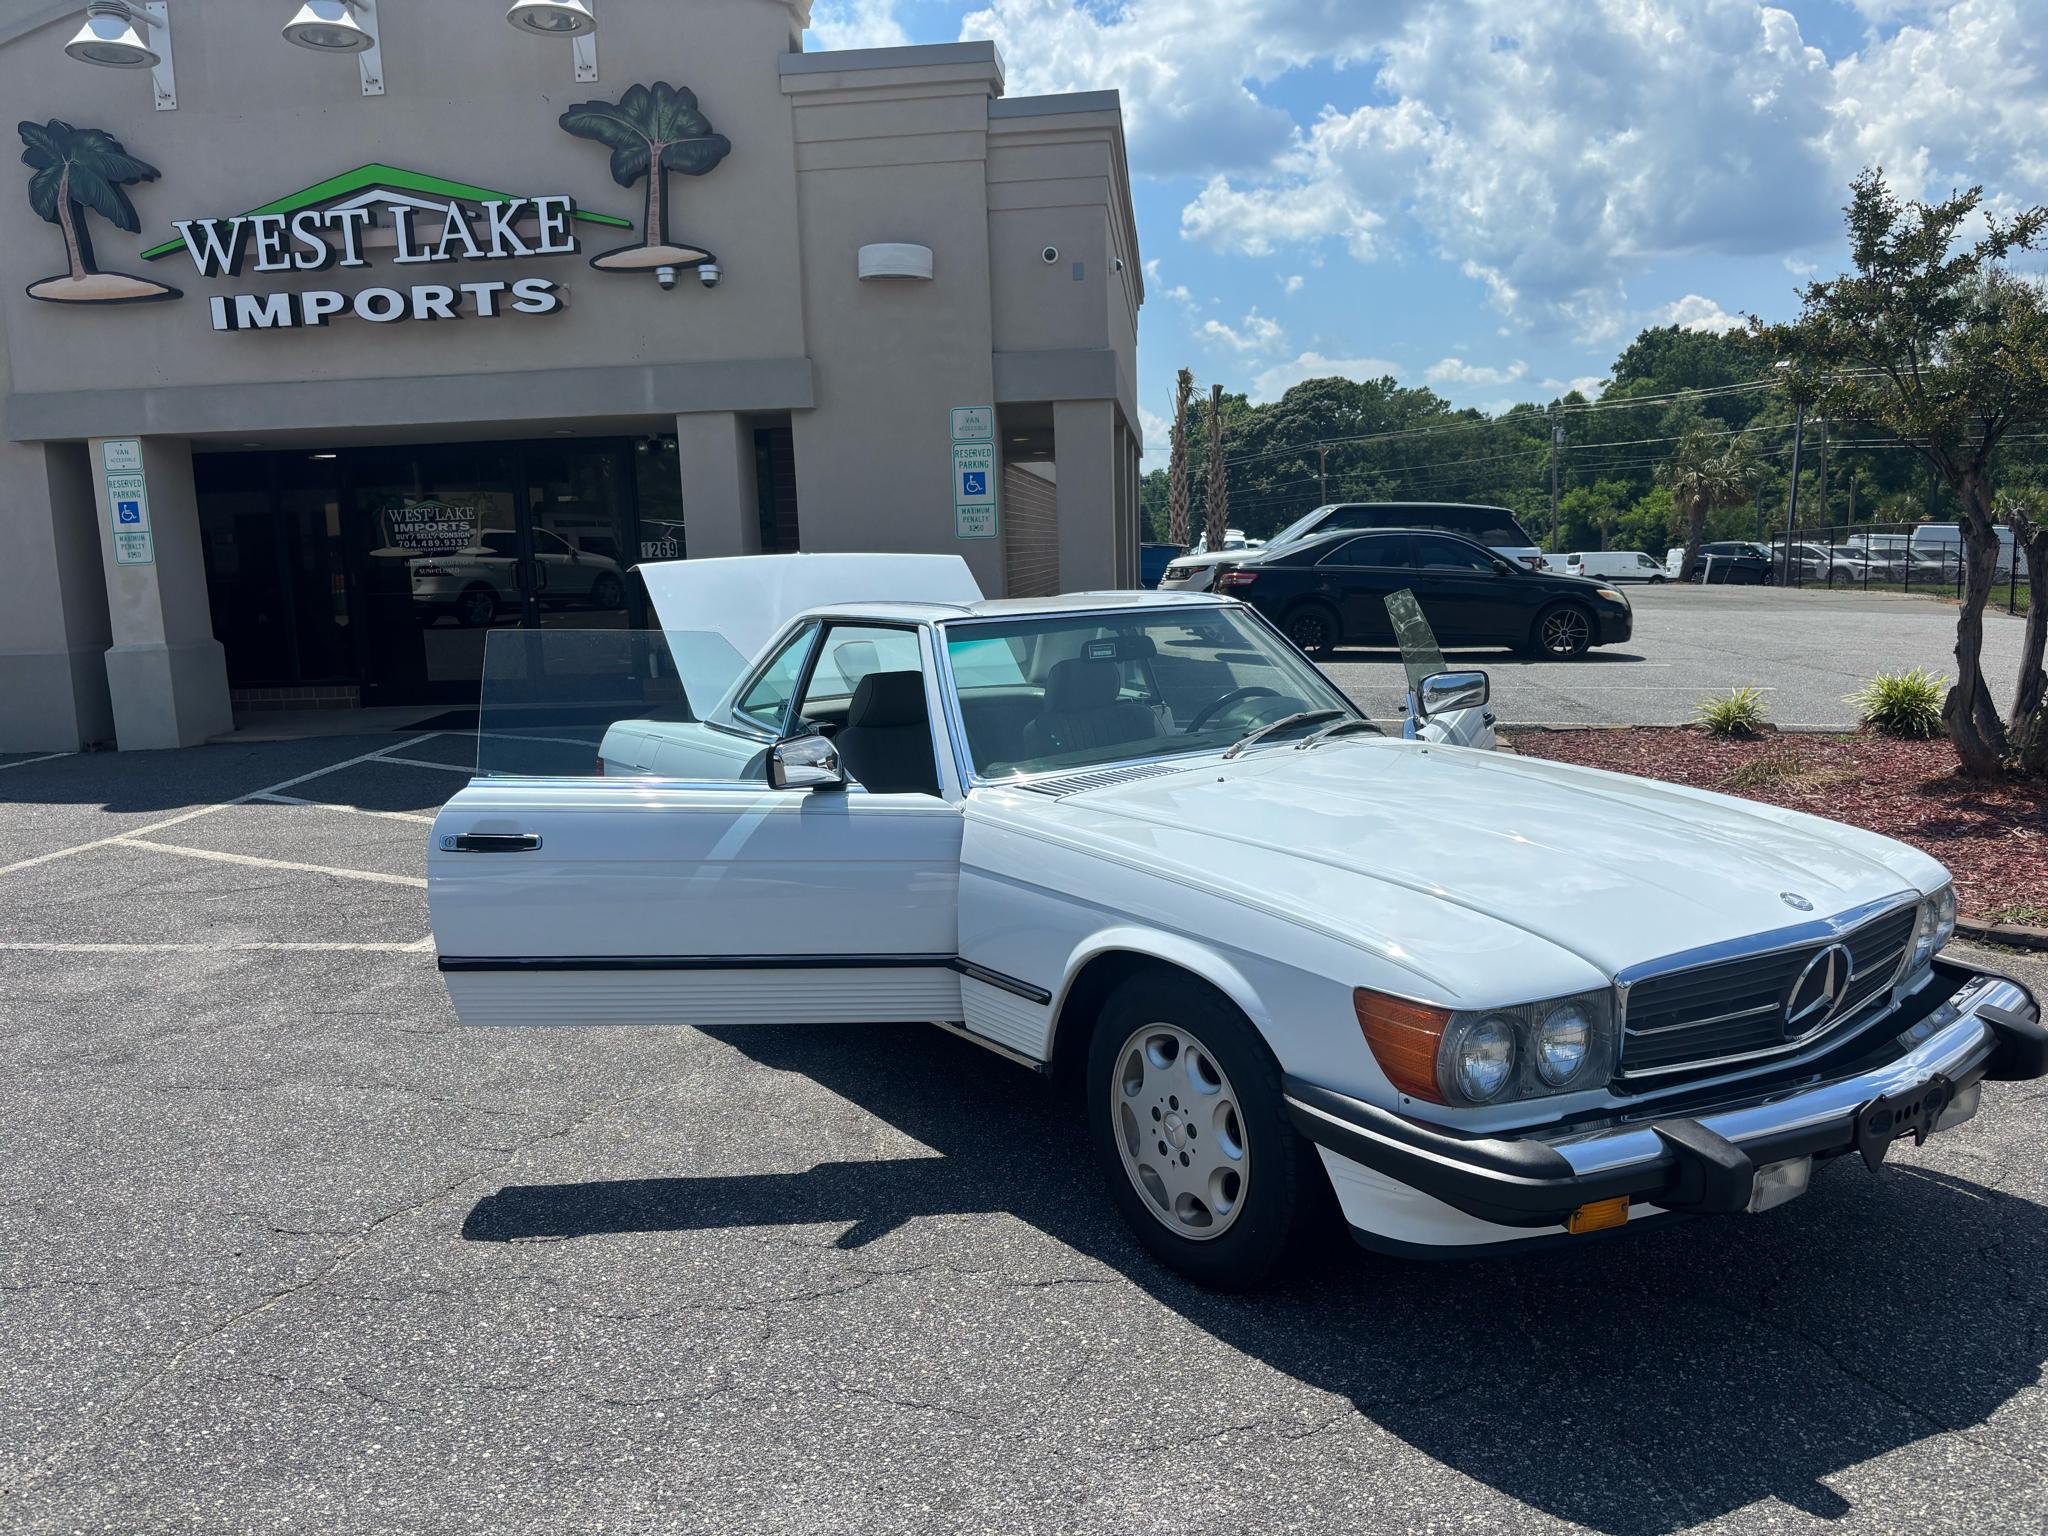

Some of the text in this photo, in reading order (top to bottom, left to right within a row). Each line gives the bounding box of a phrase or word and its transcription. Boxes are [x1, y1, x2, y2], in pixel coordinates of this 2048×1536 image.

[170, 195, 576, 277] WEST LAKE
[209, 277, 558, 331] IMPORTS
[964, 416, 980, 424] VAN
[954, 448, 992, 458] RESERVED
[958, 460, 989, 469] PARKING
[108, 479, 142, 489] RESERVED
[112, 490, 141, 499] PARKING
[388, 506, 475, 522] WEST LAKE
[961, 507, 990, 515] MAXIMUM
[962, 516, 989, 524] PENALTY
[394, 521, 470, 532] IMPORTS
[439, 531, 470, 539] CONSIGN
[398, 539, 469, 548] 704.489.9333
[642, 542, 677, 557] 1269
